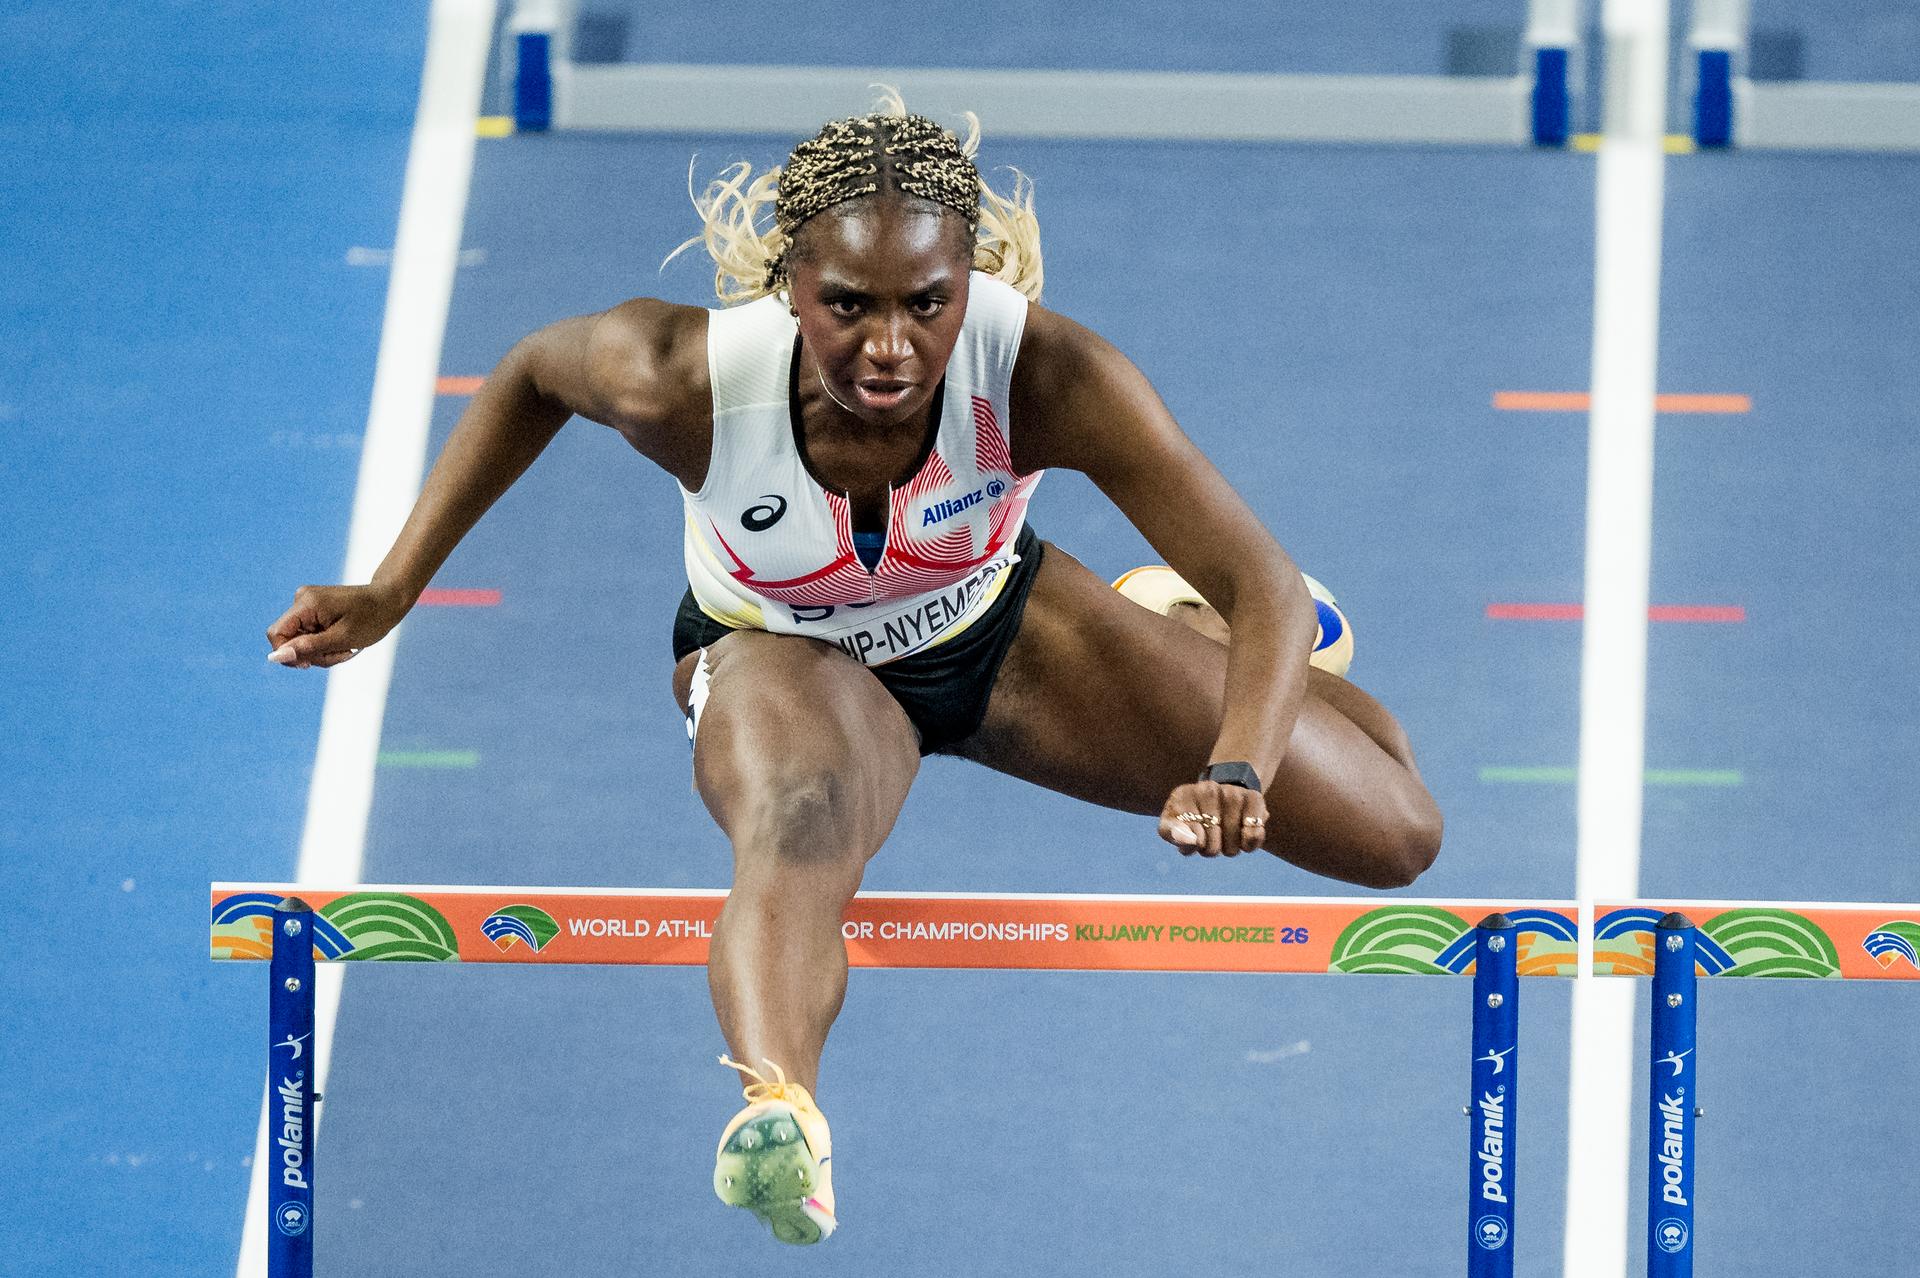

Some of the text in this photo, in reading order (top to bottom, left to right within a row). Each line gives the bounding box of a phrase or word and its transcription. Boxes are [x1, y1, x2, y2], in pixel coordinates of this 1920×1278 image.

[922, 489, 984, 527] Allianz
[568, 918, 1309, 944] WORLD ATHL OR CHAMPIONSHIPS KUJAWY POMORZE 26
[277, 1077, 308, 1189] polanik
[1478, 1090, 1508, 1204] polanik
[1658, 1092, 1688, 1206] polanik
